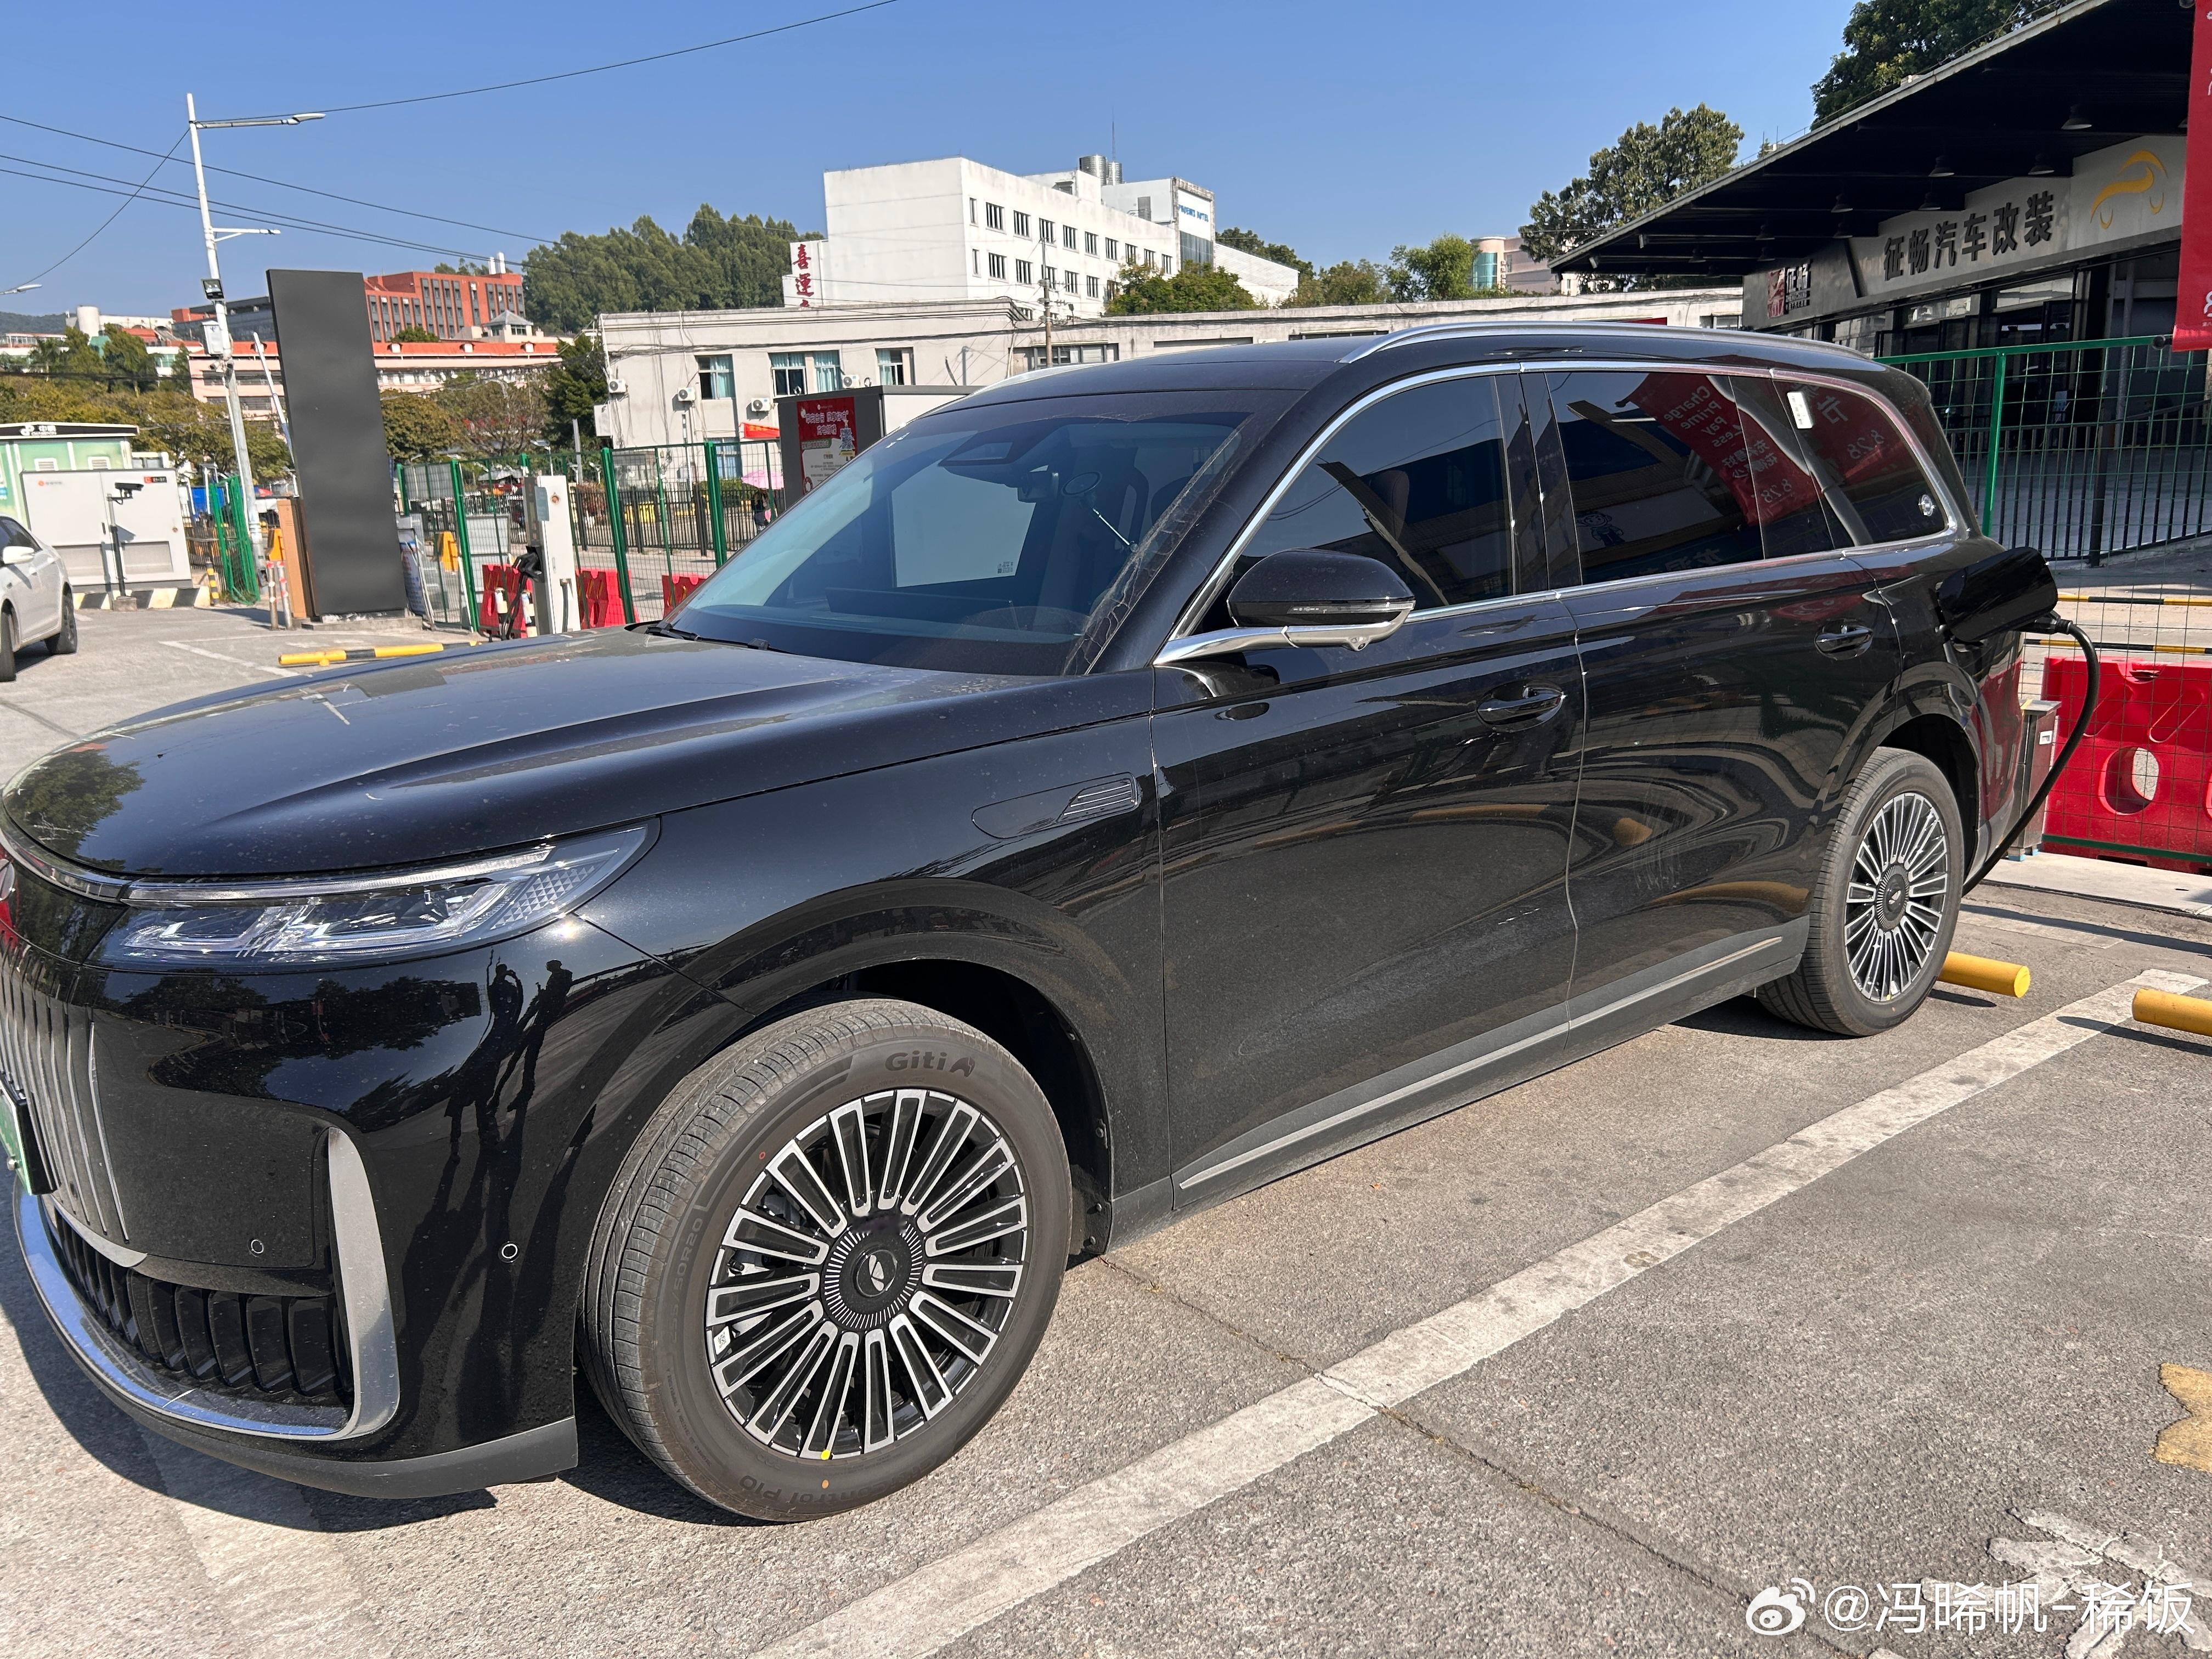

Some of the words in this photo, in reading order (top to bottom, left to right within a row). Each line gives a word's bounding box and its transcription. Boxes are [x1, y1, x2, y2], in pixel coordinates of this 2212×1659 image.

[1884, 191, 2053, 281] 征畅汽车改装
[885, 1050, 947, 1071] Giti
